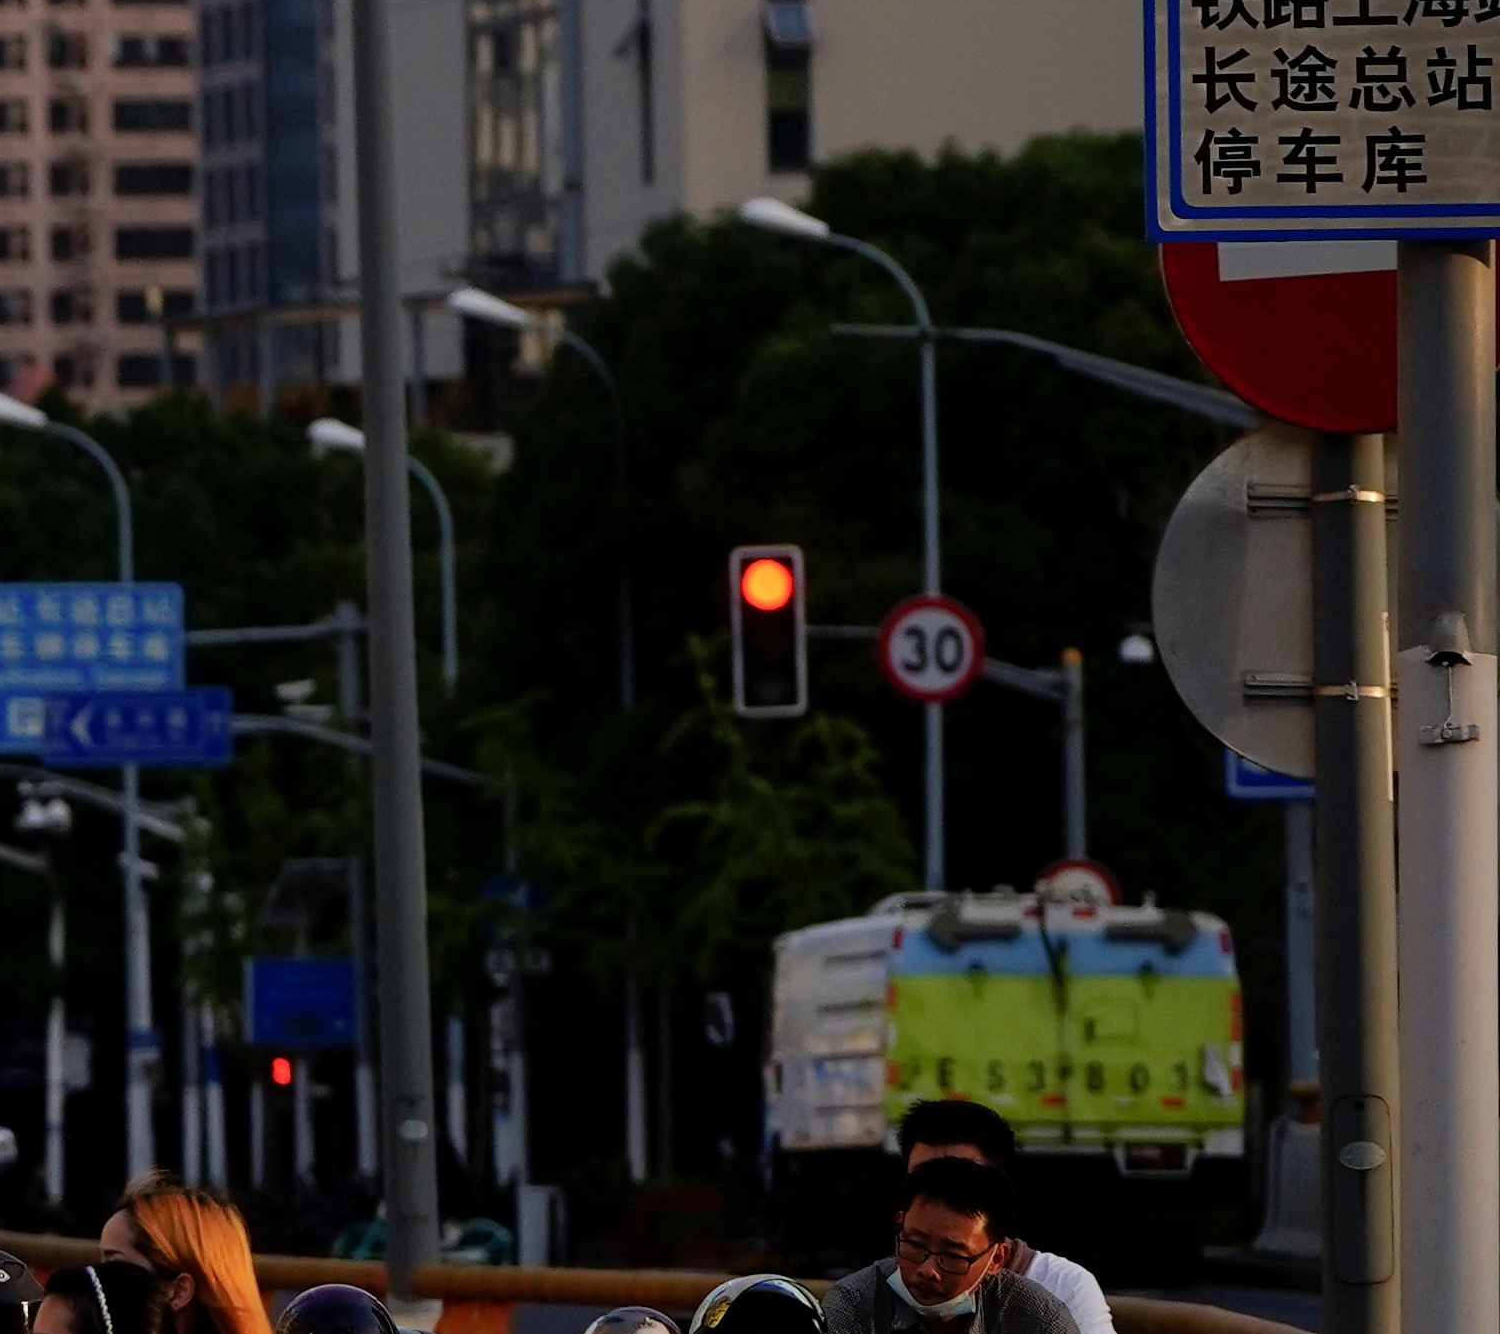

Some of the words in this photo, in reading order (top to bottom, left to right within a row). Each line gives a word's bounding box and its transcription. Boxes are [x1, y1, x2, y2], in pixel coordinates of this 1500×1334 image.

[1193, 45, 1493, 113] 长途总站
[1193, 126, 1428, 195] 停车库
[900, 625, 963, 673] 30
